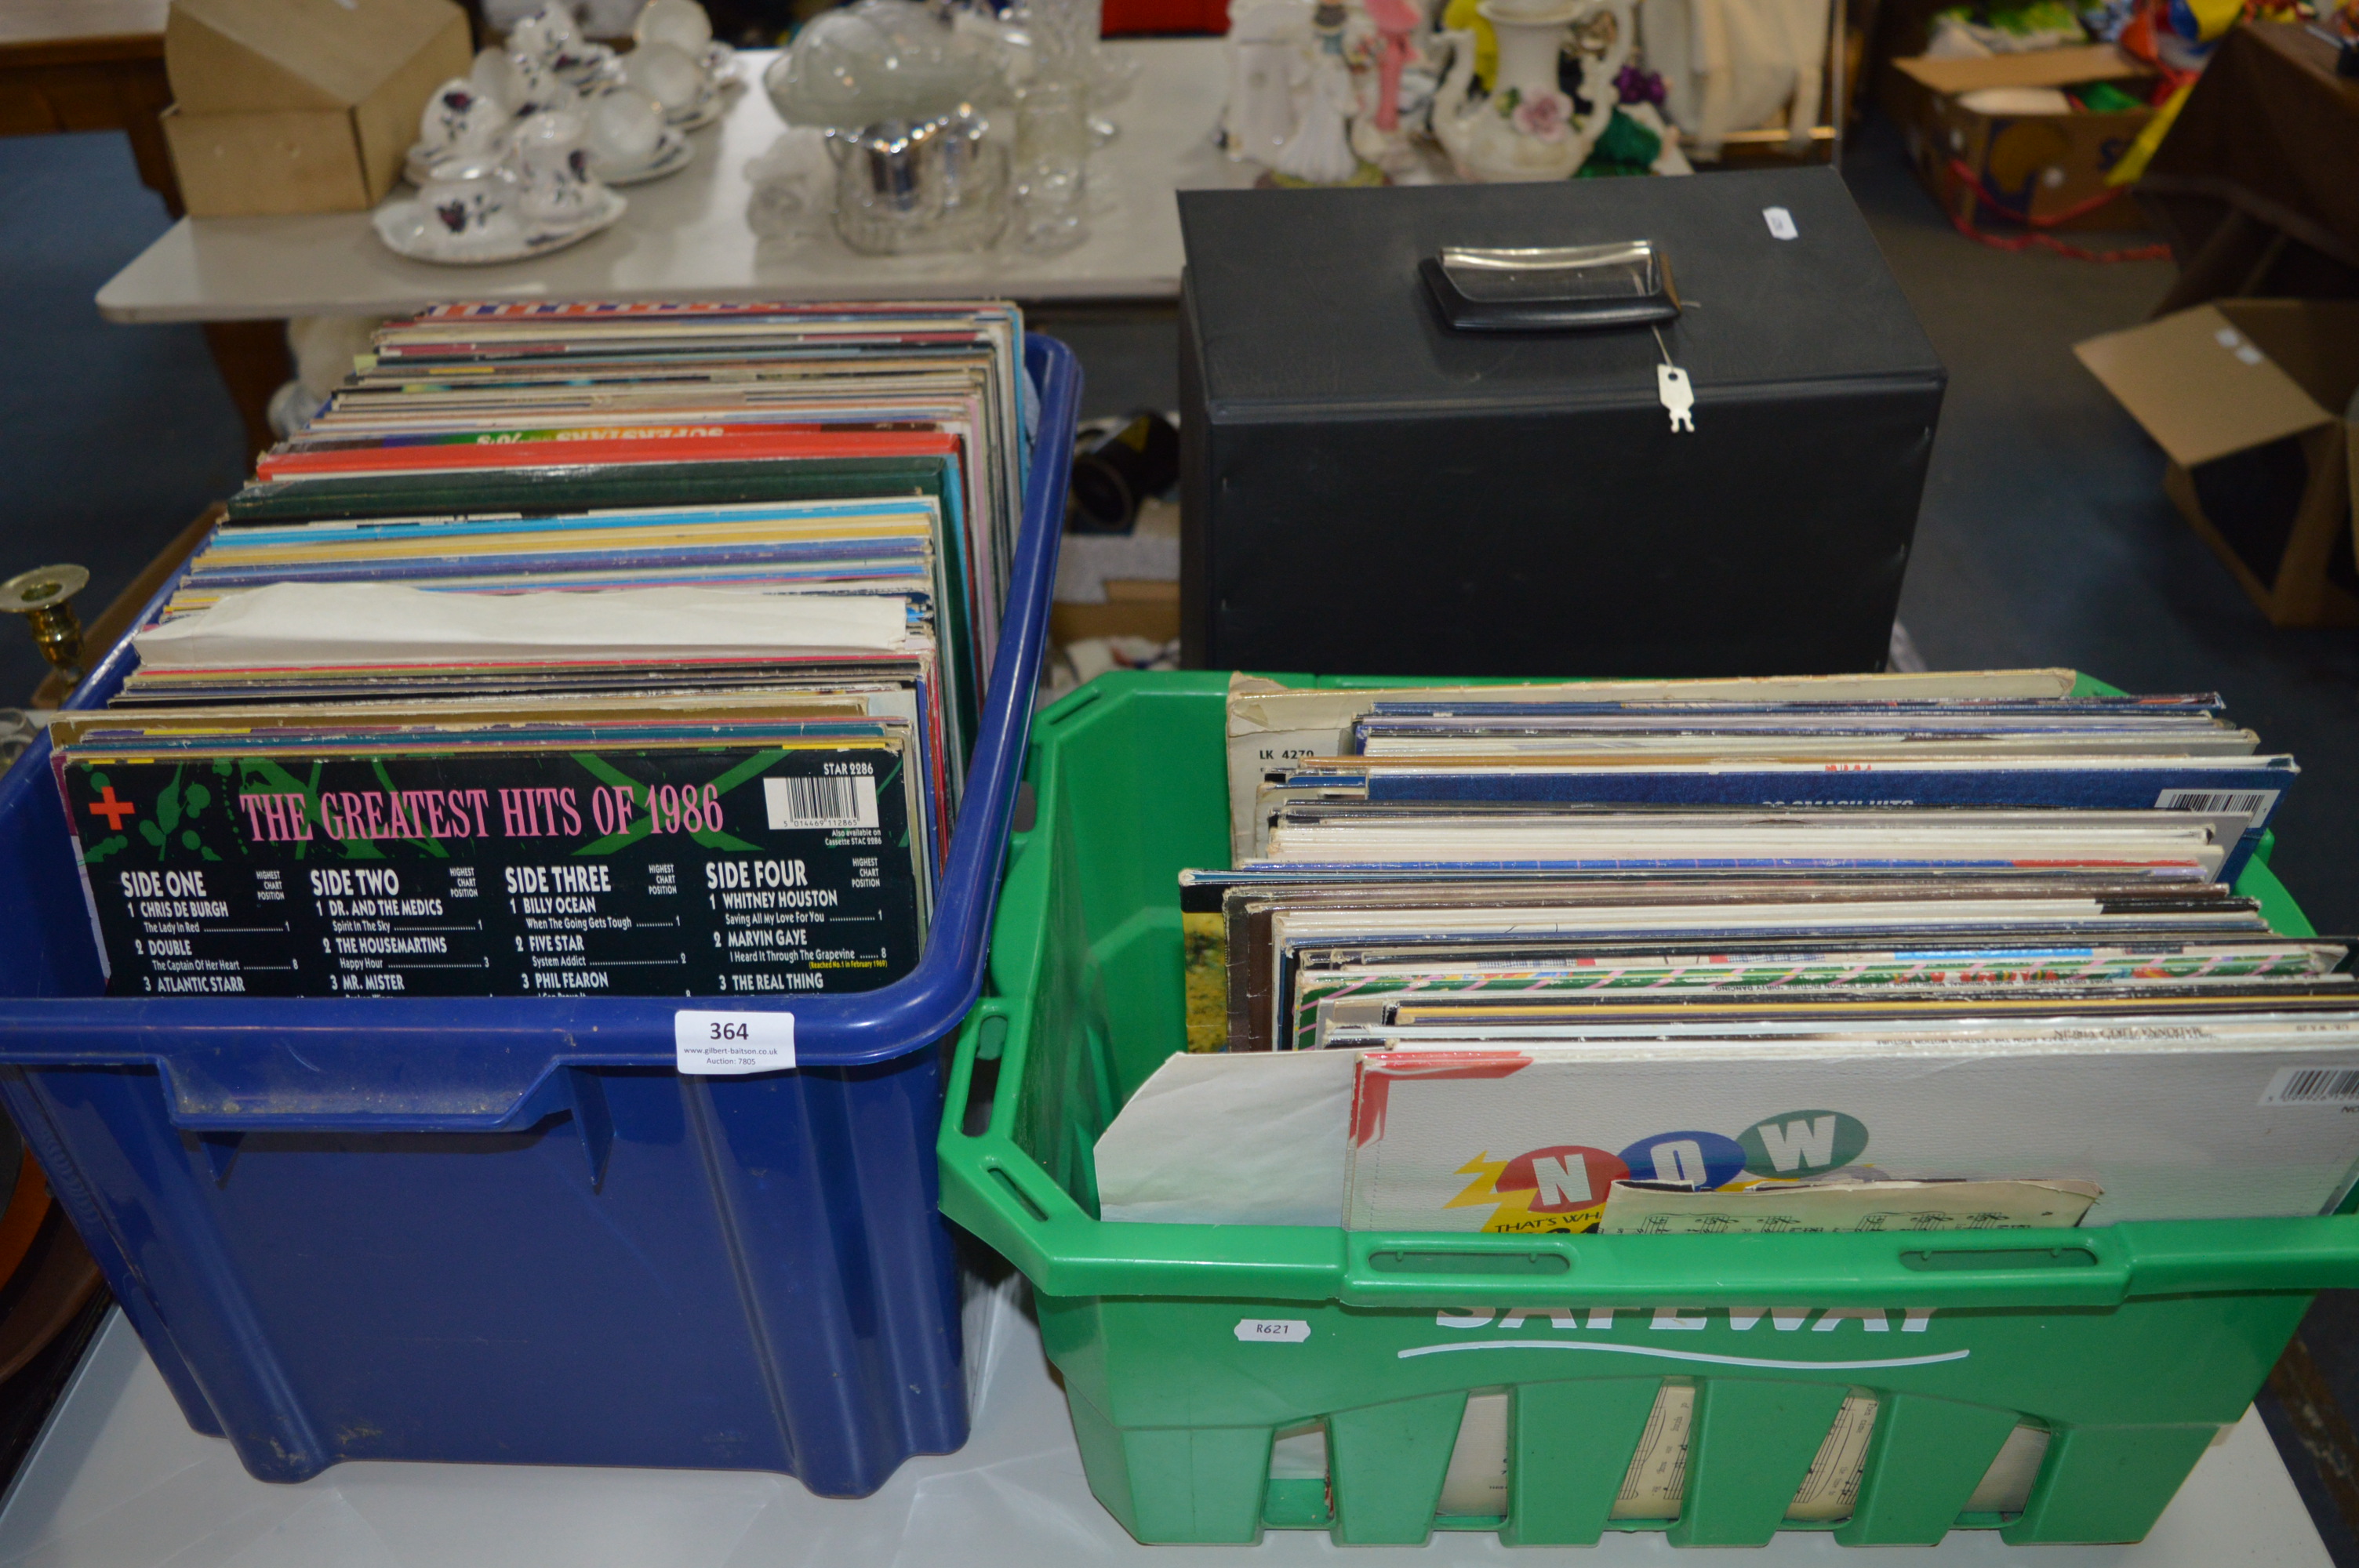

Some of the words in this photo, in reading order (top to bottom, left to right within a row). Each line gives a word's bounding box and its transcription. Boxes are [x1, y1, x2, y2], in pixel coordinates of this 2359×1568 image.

[1259, 750, 1274, 760] LK
[823, 763, 848, 775] STAR
[850, 763, 873, 775] 2286
[238, 793, 314, 841] THE
[322, 789, 489, 840] GREATEST
[499, 787, 582, 837] HITS
[593, 786, 634, 835] OF
[645, 783, 723, 834] 1986
[649, 864, 674, 873] HIGHEST
[852, 858, 878, 866] HIGHEST
[256, 871, 279, 880] HIGHEST
[450, 868, 474, 877] HIGHEST
[505, 867, 549, 893] SIDE
[551, 866, 611, 892] THREE
[656, 875, 674, 884] CHART
[706, 862, 750, 889] SIDE
[754, 860, 808, 887] FOUR
[860, 868, 878, 877] CHART
[121, 872, 163, 897] SIDE
[166, 871, 206, 897] ONE
[311, 870, 354, 895] SIDE
[355, 869, 398, 895] TWO
[457, 878, 475, 887] CHART
[852, 878, 880, 887] POSITION
[257, 891, 284, 900] POSITION
[450, 888, 478, 897] POSITION
[649, 886, 677, 895] POSITION
[510, 898, 516, 913] 1
[523, 898, 552, 913] BILLY
[555, 897, 596, 913] OCEAN
[710, 894, 715, 909] 1
[723, 892, 775, 909] WHITNEY
[778, 890, 838, 907] HOUSTON
[128, 902, 134, 917] 1
[140, 902, 173, 917] CHRIS
[173, 902, 189, 917] DE
[190, 902, 228, 917] BURGH
[316, 901, 322, 916] 1
[329, 900, 349, 916] DR.
[352, 900, 376, 916] AND
[377, 900, 399, 916] THE
[402, 899, 442, 915] MEDICS
[526, 918, 547, 929] When
[548, 918, 563, 928] The
[565, 917, 587, 931] Going
[588, 917, 606, 928] Gets
[607, 916, 631, 930] Tough
[676, 916, 680, 926] 1
[725, 913, 751, 927] Saving
[752, 913, 762, 924] All
[764, 913, 774, 925] My
[776, 913, 794, 923] Love
[795, 911, 808, 923] For
[809, 911, 824, 922] You
[878, 909, 881, 920] 1
[144, 922, 158, 932] The
[158, 922, 176, 935] Lady
[176, 922, 184, 932] In
[185, 922, 200, 932] Red
[285, 921, 289, 931] 1
[333, 920, 353, 933] Spirit
[354, 920, 362, 931] In
[362, 920, 376, 931] The
[377, 920, 390, 933] Sky
[478, 920, 482, 930] 1
[323, 938, 331, 953] 2
[336, 938, 358, 953] THE
[359, 937, 447, 953] HOUSEMARTINS
[516, 936, 523, 952] 2
[529, 936, 553, 951] FIVE
[555, 935, 584, 951] STAR
[714, 931, 722, 947] 2
[729, 930, 773, 947] MARVIN
[776, 929, 807, 946] GAYE
[135, 939, 144, 954] 2
[148, 940, 192, 955] DOUBLE
[533, 956, 559, 968] System
[561, 956, 586, 966] Addict
[681, 953, 686, 964] 2
[730, 952, 732, 962] I
[734, 951, 758, 962] Heard
[759, 951, 765, 961] It
[766, 950, 798, 964] Through
[800, 949, 814, 960] The
[816, 949, 855, 961] Grapevine
[881, 947, 886, 958] 8
[152, 960, 166, 971] The
[167, 960, 194, 972] Captain
[194, 960, 204, 970] Of
[205, 960, 218, 970] Her
[219, 960, 240, 970] Heart
[293, 959, 298, 969] 8
[340, 958, 363, 971] Happy
[365, 958, 383, 968] Hour
[484, 956, 489, 967] 3
[144, 977, 151, 991] 3
[158, 977, 209, 992] ATLANTIC
[210, 977, 245, 992] STARR
[330, 975, 337, 989] 3
[343, 975, 363, 989] MR.
[365, 975, 405, 989] MISTER
[522, 974, 529, 989] 3
[535, 973, 561, 988] PHIL
[562, 972, 609, 988] FEARON
[719, 975, 726, 990] 3
[732, 975, 754, 990] THE
[756, 974, 784, 989] REAL
[786, 973, 823, 989] THING
[709, 1022, 749, 1042] 364
[1495, 1218, 1557, 1233] THAT'S
[1563, 1211, 1602, 1224] WH
[1256, 1323, 1289, 1334] R621
